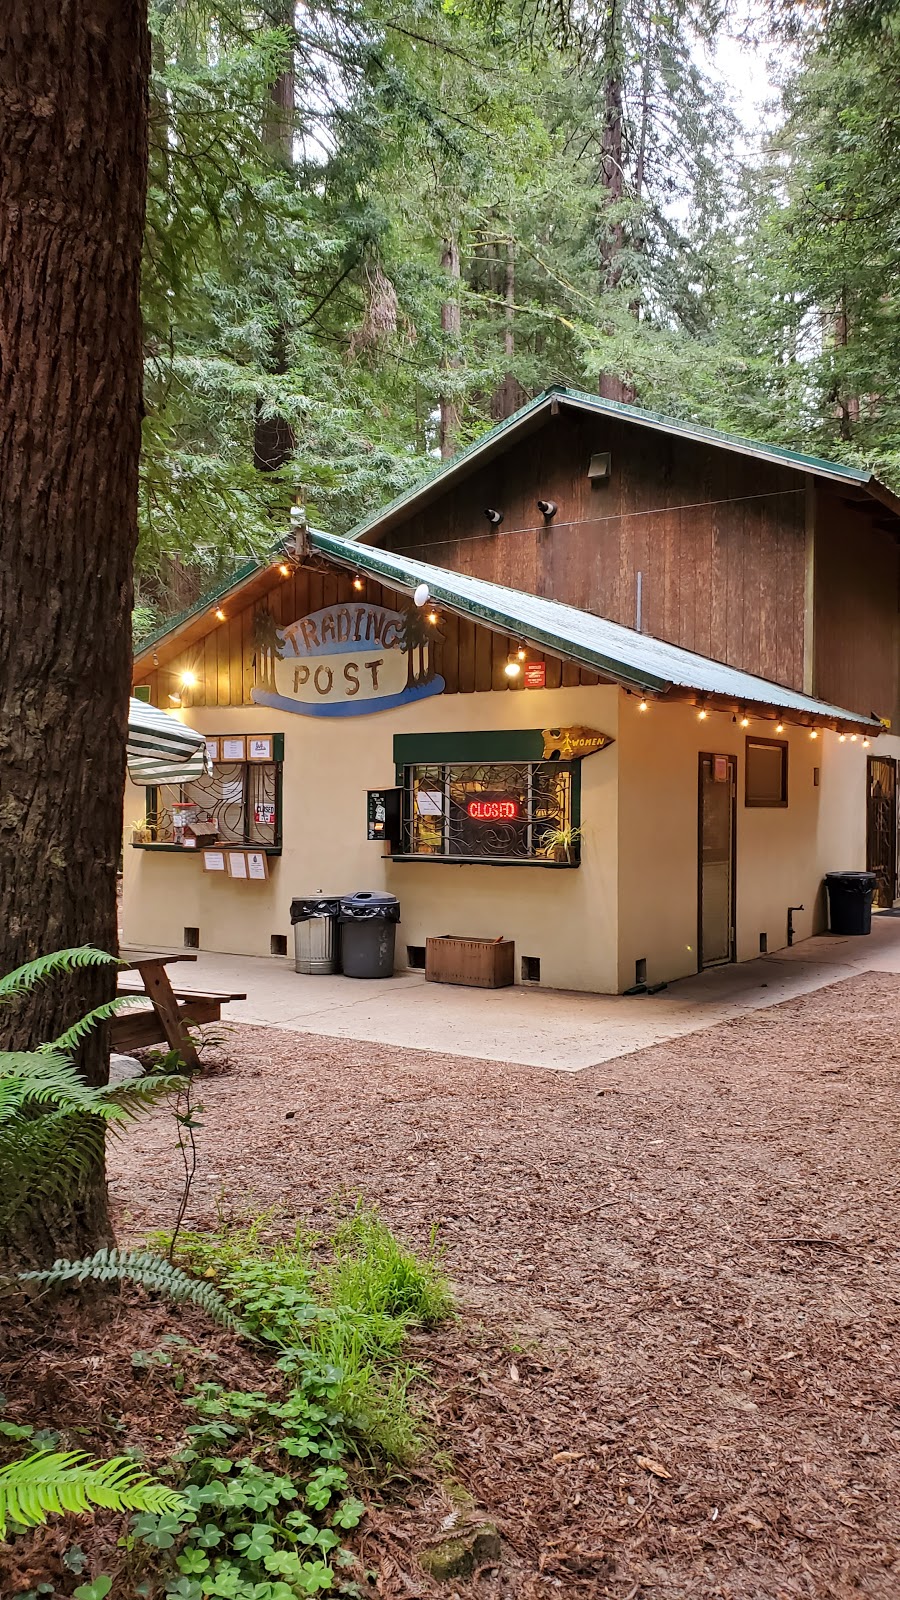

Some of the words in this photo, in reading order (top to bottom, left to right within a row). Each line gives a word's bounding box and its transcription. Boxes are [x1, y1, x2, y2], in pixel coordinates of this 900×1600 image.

[284, 608, 402, 656] TRADING
[292, 659, 384, 695] POST
[572, 738, 605, 747] WOMEN
[469, 802, 515, 817] CLOSED
